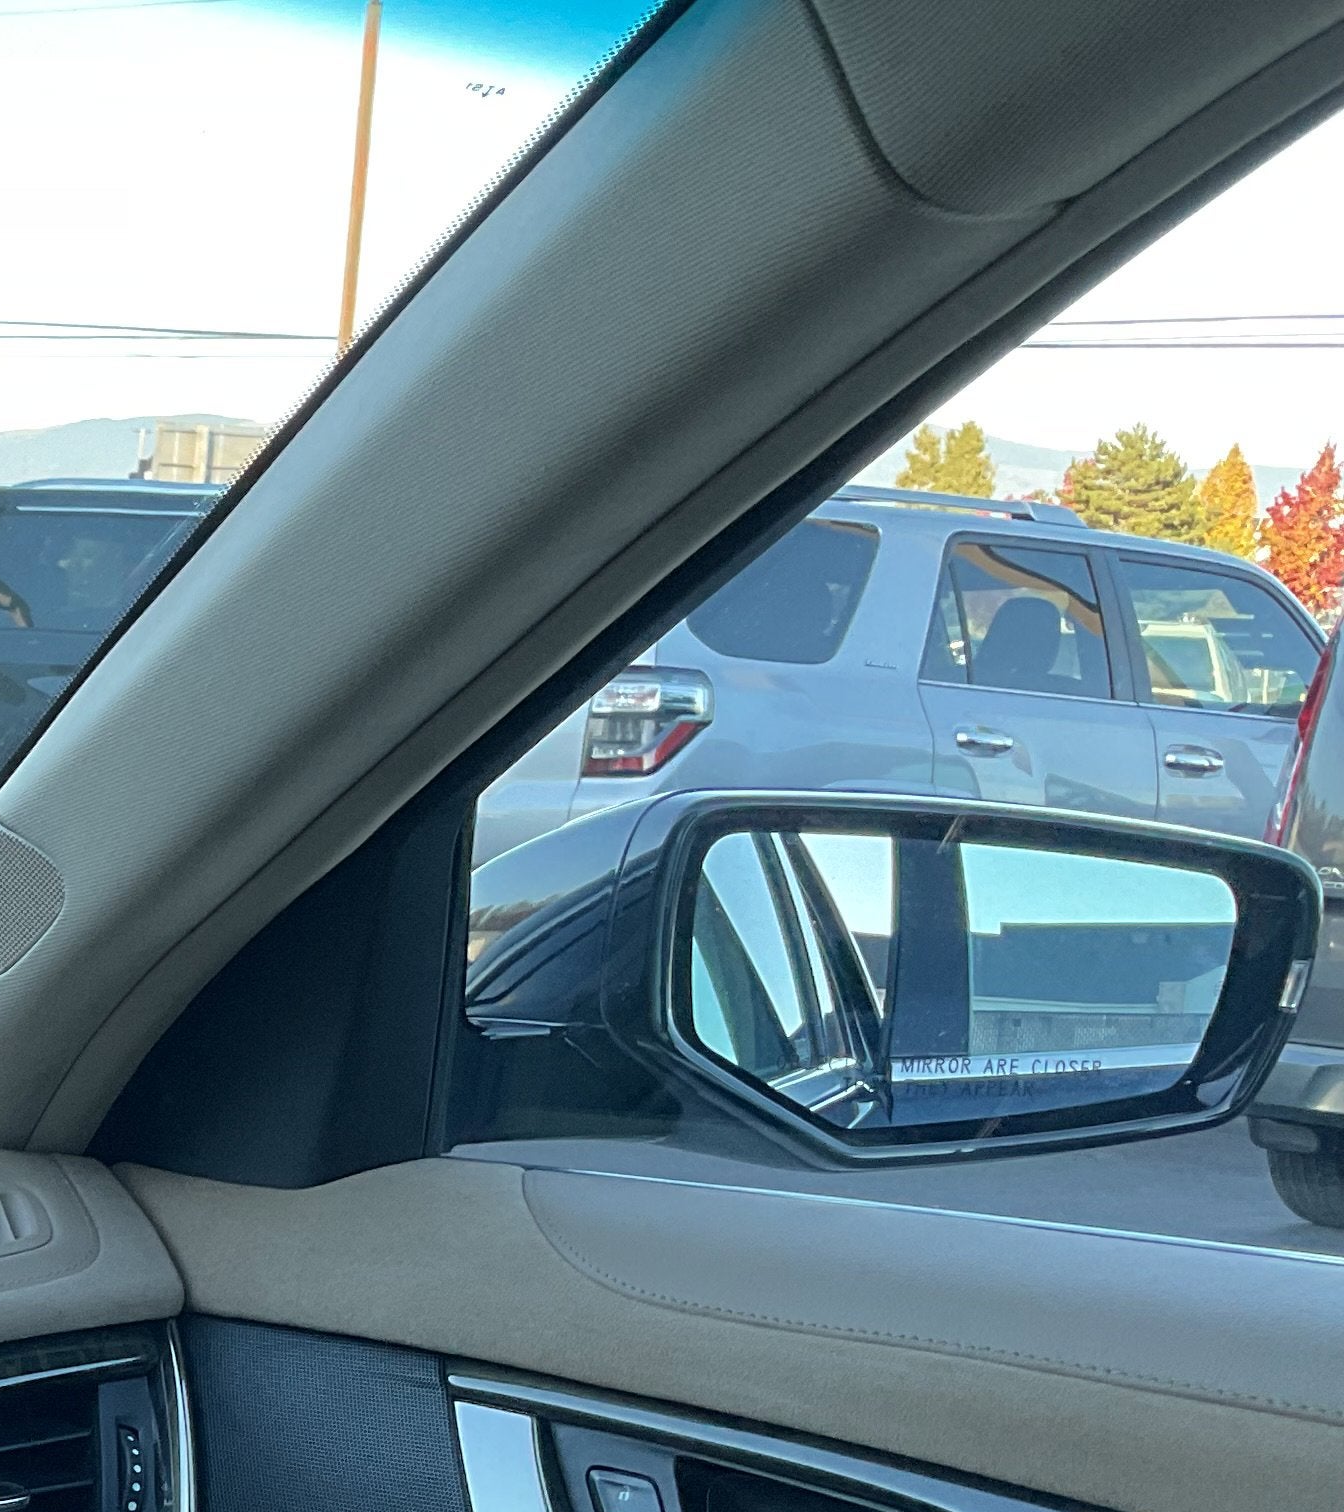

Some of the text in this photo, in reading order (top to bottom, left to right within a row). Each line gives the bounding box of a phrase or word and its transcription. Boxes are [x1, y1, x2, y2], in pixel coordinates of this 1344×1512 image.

[900, 1056, 972, 1075] MIRROR
[983, 1058, 1020, 1076] ARE
[1032, 1059, 1103, 1076] CLOSER
[961, 1081, 1035, 1097] APPEAR
